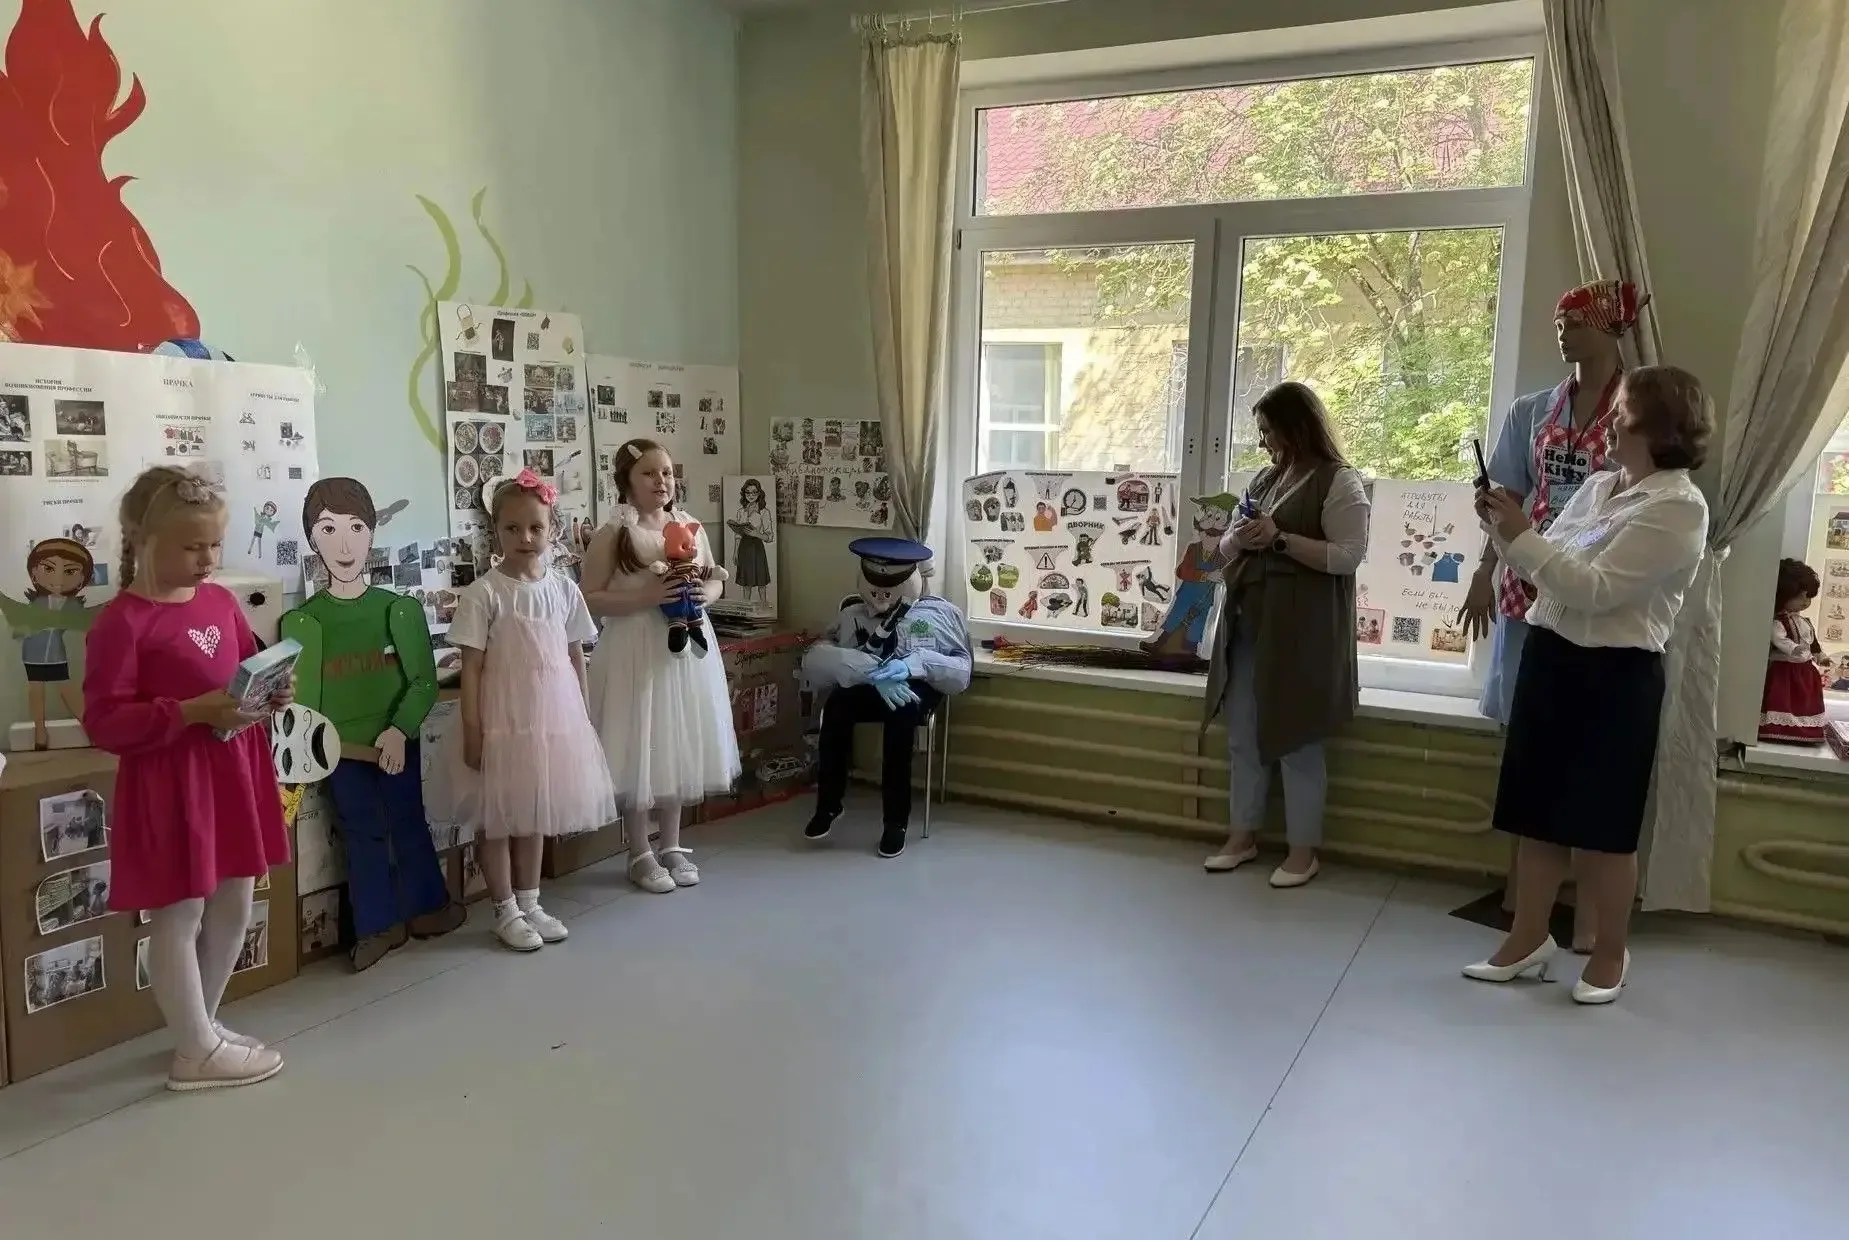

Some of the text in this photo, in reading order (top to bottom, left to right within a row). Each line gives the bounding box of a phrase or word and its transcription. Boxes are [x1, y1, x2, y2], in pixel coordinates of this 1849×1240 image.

[163, 378, 194, 388] ПРАЧКА
[1544, 462, 1587, 482] Kity
[1067, 521, 1105, 530] ДВОРНИК
